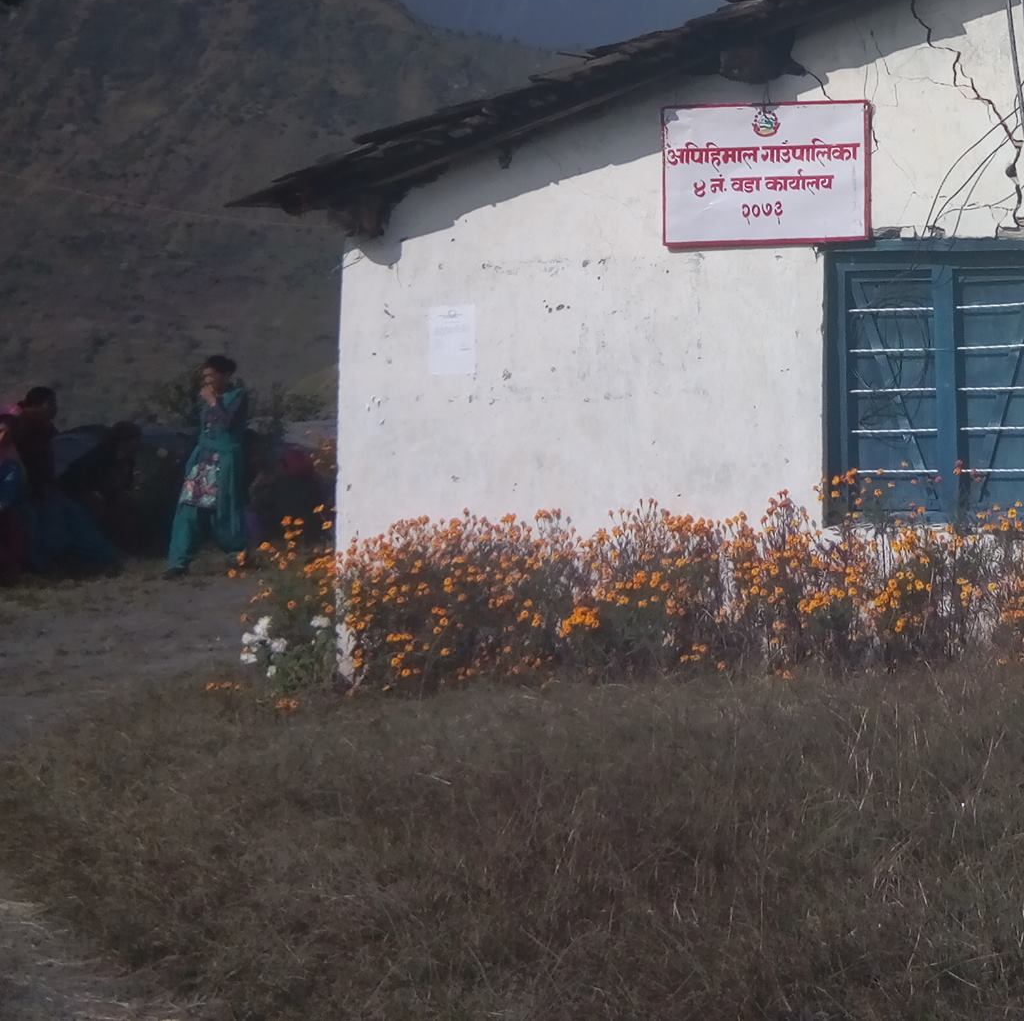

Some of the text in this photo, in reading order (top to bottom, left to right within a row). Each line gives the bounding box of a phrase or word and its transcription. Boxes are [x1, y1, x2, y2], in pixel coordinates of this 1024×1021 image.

[667, 138, 860, 173] अपिहिमाल गाउँपालिका
[693, 179, 706, 198] ४
[731, 177, 762, 193] वडा
[764, 168, 835, 196] कार्यालय
[742, 201, 784, 225] २०७३
